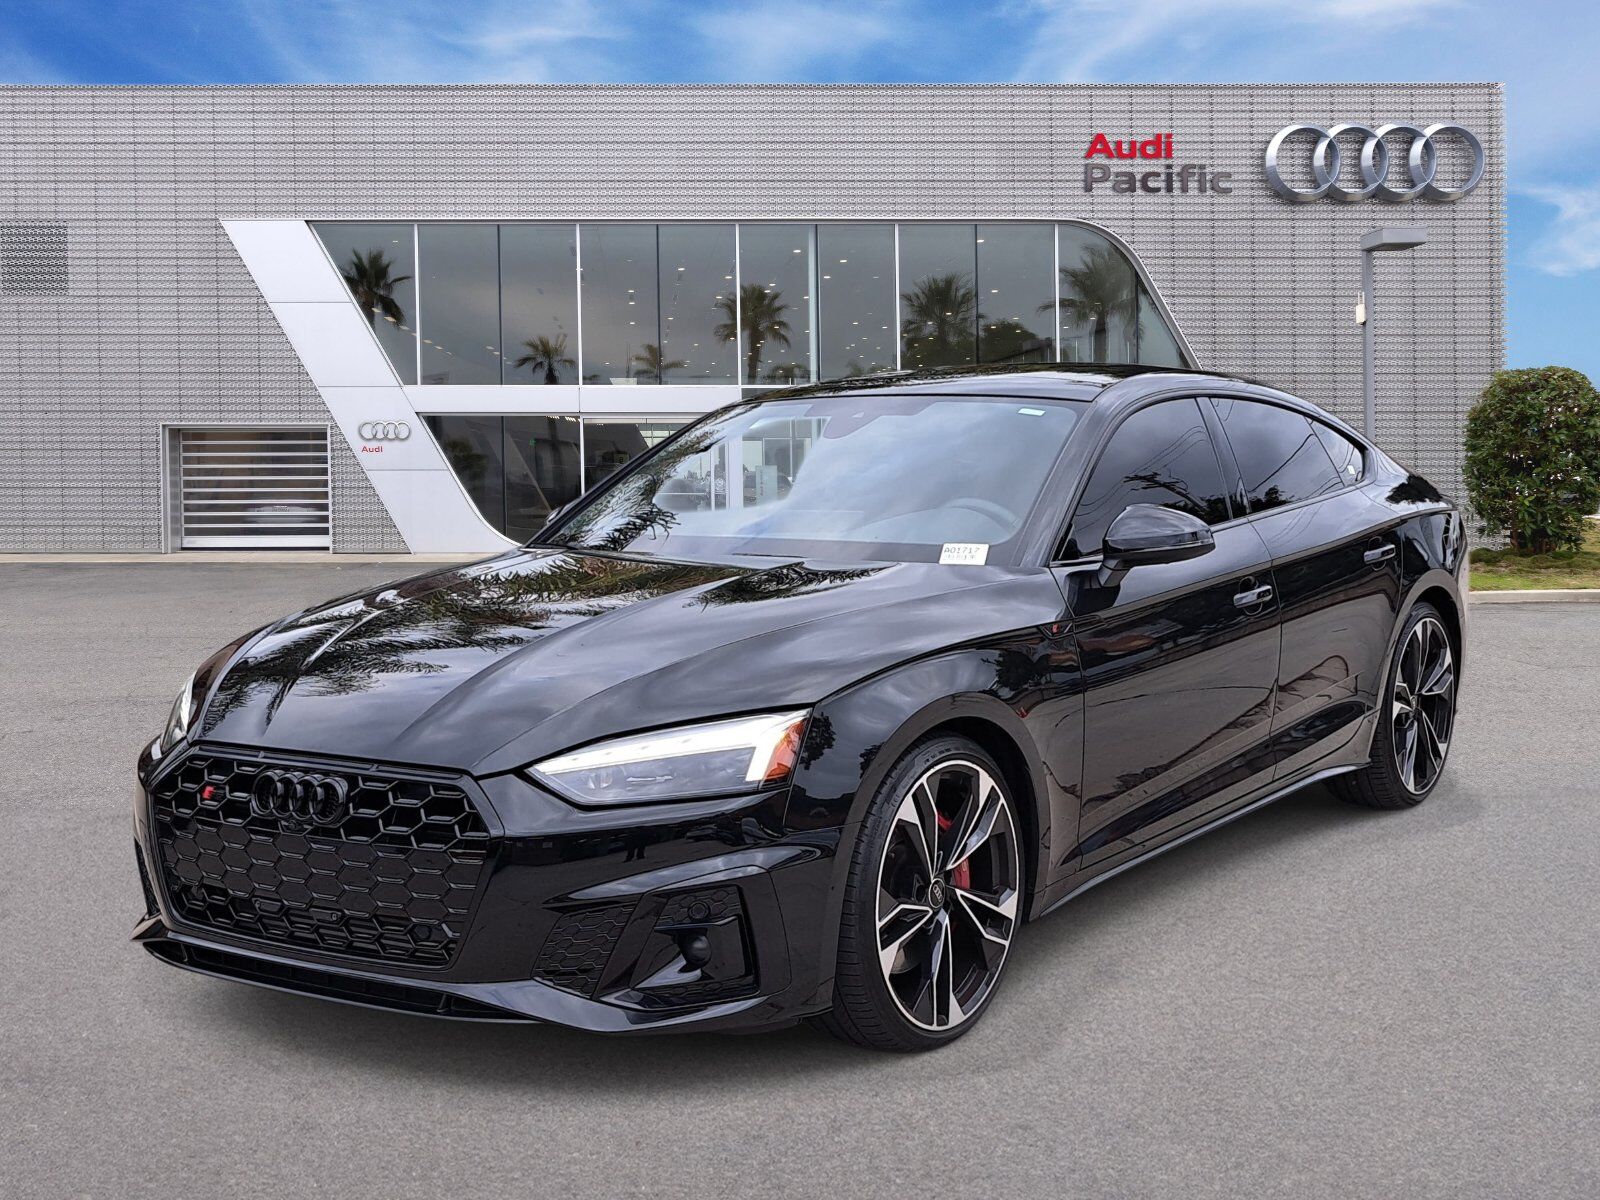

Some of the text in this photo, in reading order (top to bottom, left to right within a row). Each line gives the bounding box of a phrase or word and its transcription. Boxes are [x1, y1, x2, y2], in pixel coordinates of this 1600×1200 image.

[1085, 133, 1174, 159] Audi
[1084, 163, 1233, 194] Pacific
[361, 445, 383, 453] Audi
